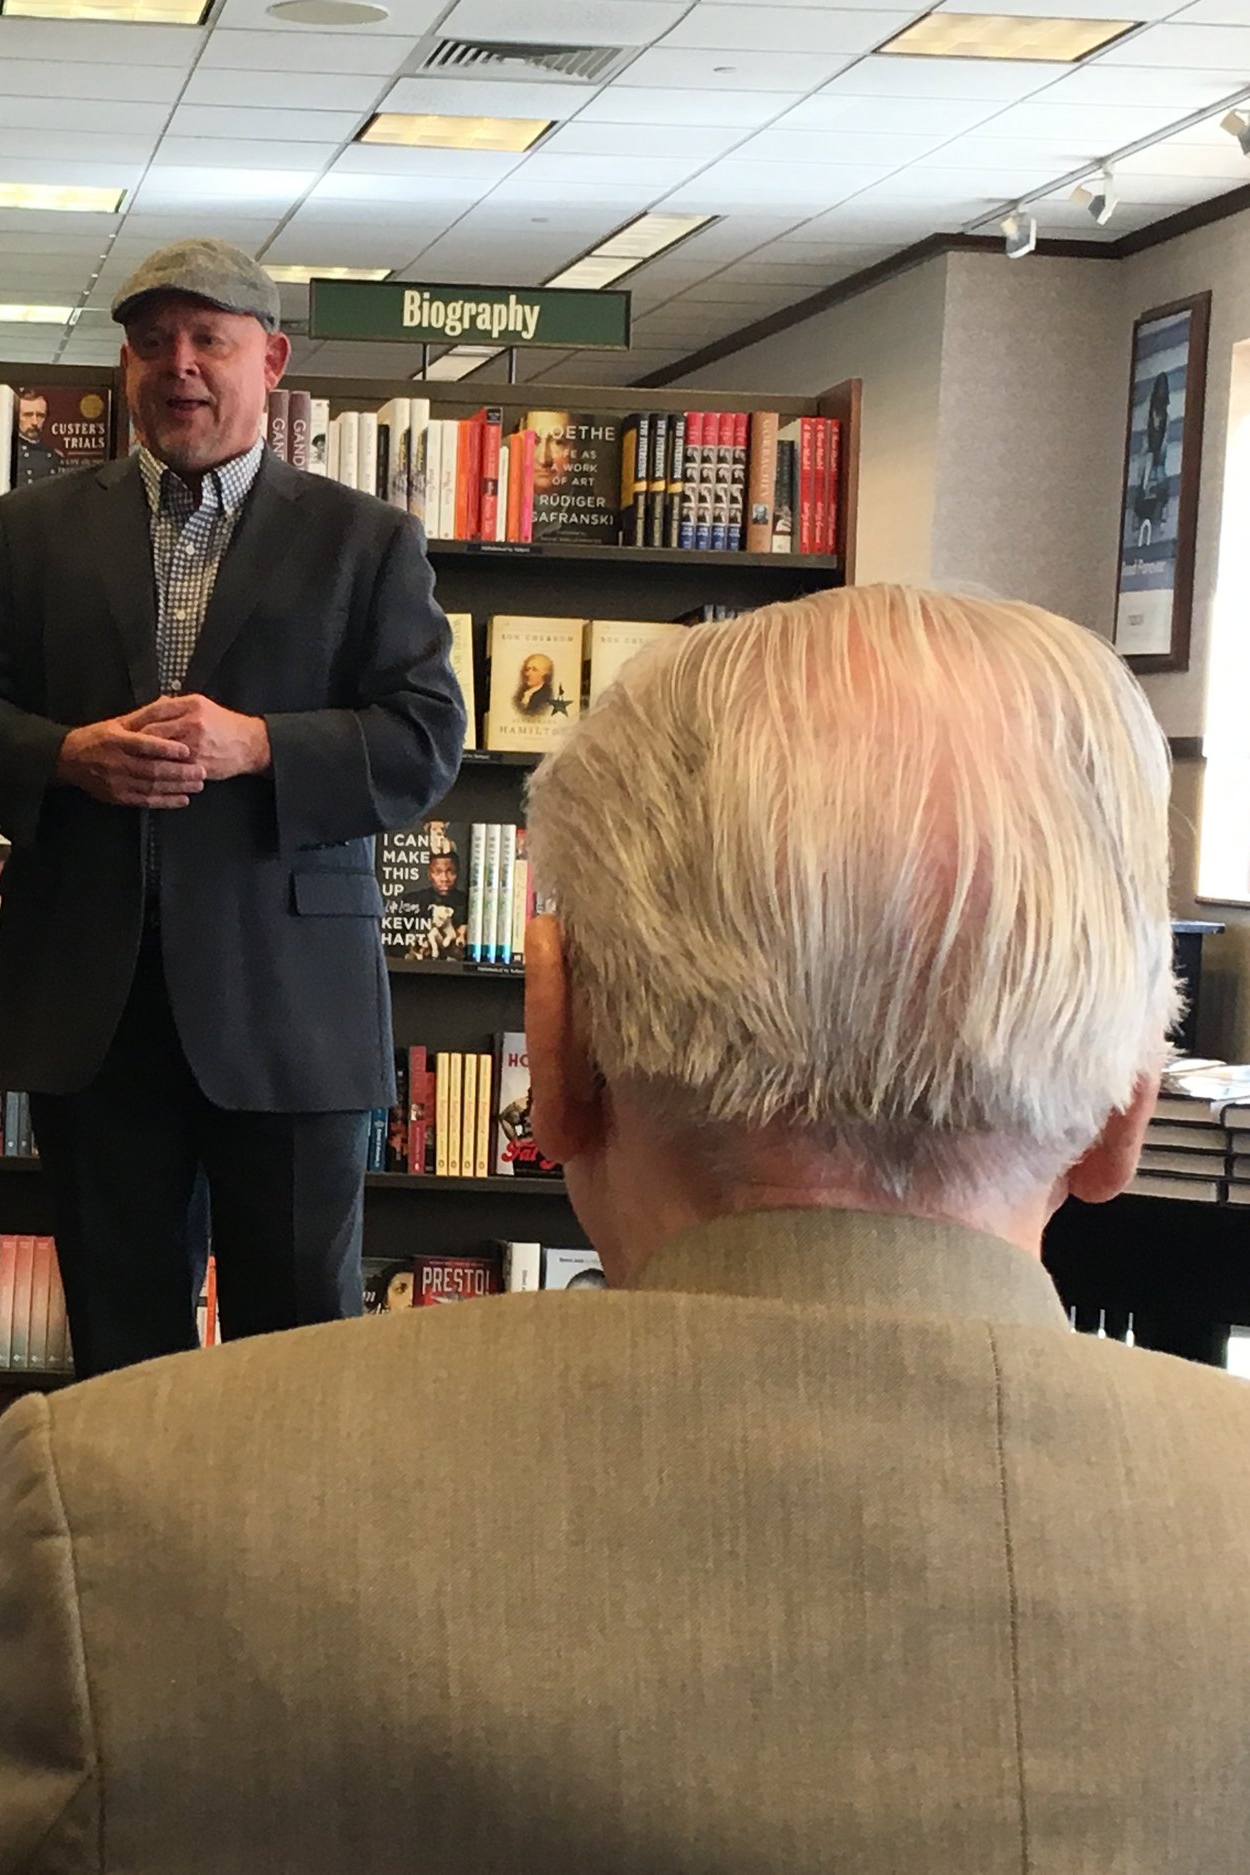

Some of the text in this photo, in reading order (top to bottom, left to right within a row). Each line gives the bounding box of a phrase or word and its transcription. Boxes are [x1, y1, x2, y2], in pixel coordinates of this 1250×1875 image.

[403, 290, 540, 340] Biography
[51, 422, 105, 435] CUSTER'S
[63, 436, 105, 448] TRIALS
[292, 420, 306, 470] GAND
[582, 450, 597, 460] AS
[760, 418, 772, 498] GORBACHEV
[563, 464, 598, 472] WORK
[552, 476, 595, 486] OF ART
[540, 493, 606, 508] RÜDIGER
[532, 511, 614, 526] SAFRANSKI
[383, 834, 388, 846] I
[383, 850, 430, 864] MAKE
[383, 866, 420, 880] THIS
[382, 884, 404, 896] UP
[382, 917, 432, 930] KEVIN
[382, 933, 428, 946] HART
[422, 1267, 490, 1296] PRESTO!
